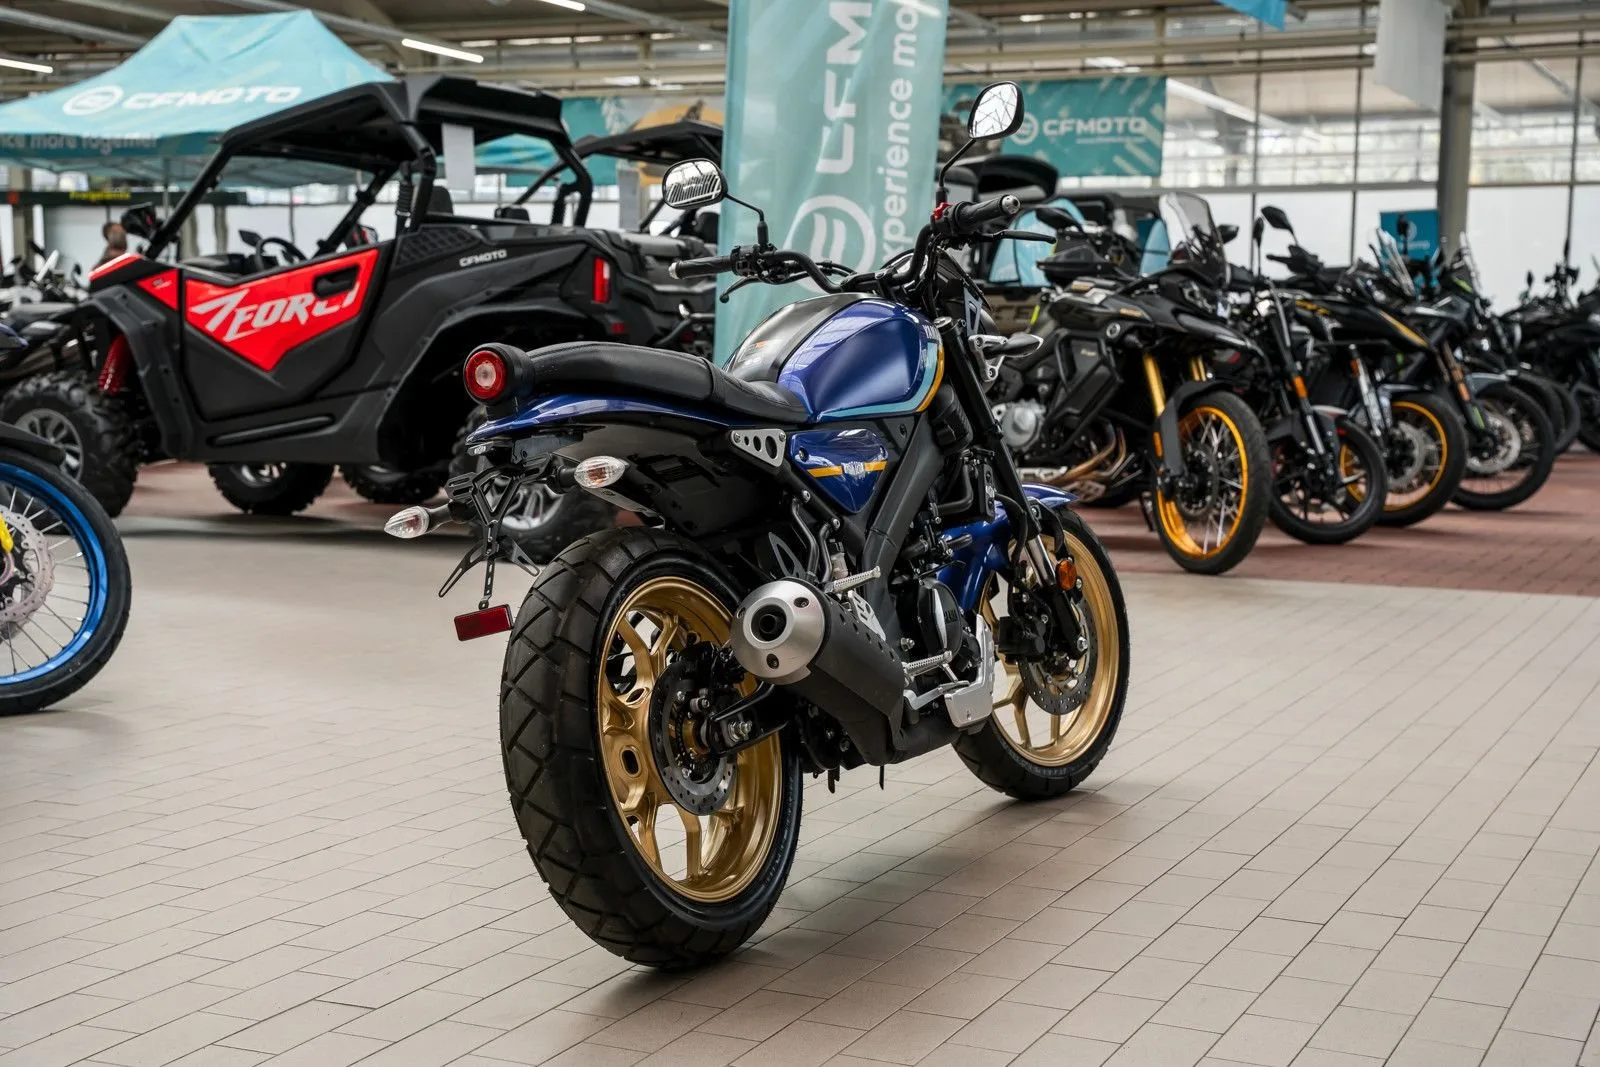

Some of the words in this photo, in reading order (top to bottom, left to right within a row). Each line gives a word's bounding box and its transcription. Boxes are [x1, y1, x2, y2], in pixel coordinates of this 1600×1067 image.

[122, 86, 303, 109] CFMOTO
[1043, 115, 1148, 136] CFMOTO
[876, 78, 914, 263] xperience
[459, 249, 507, 267] CFMOTO
